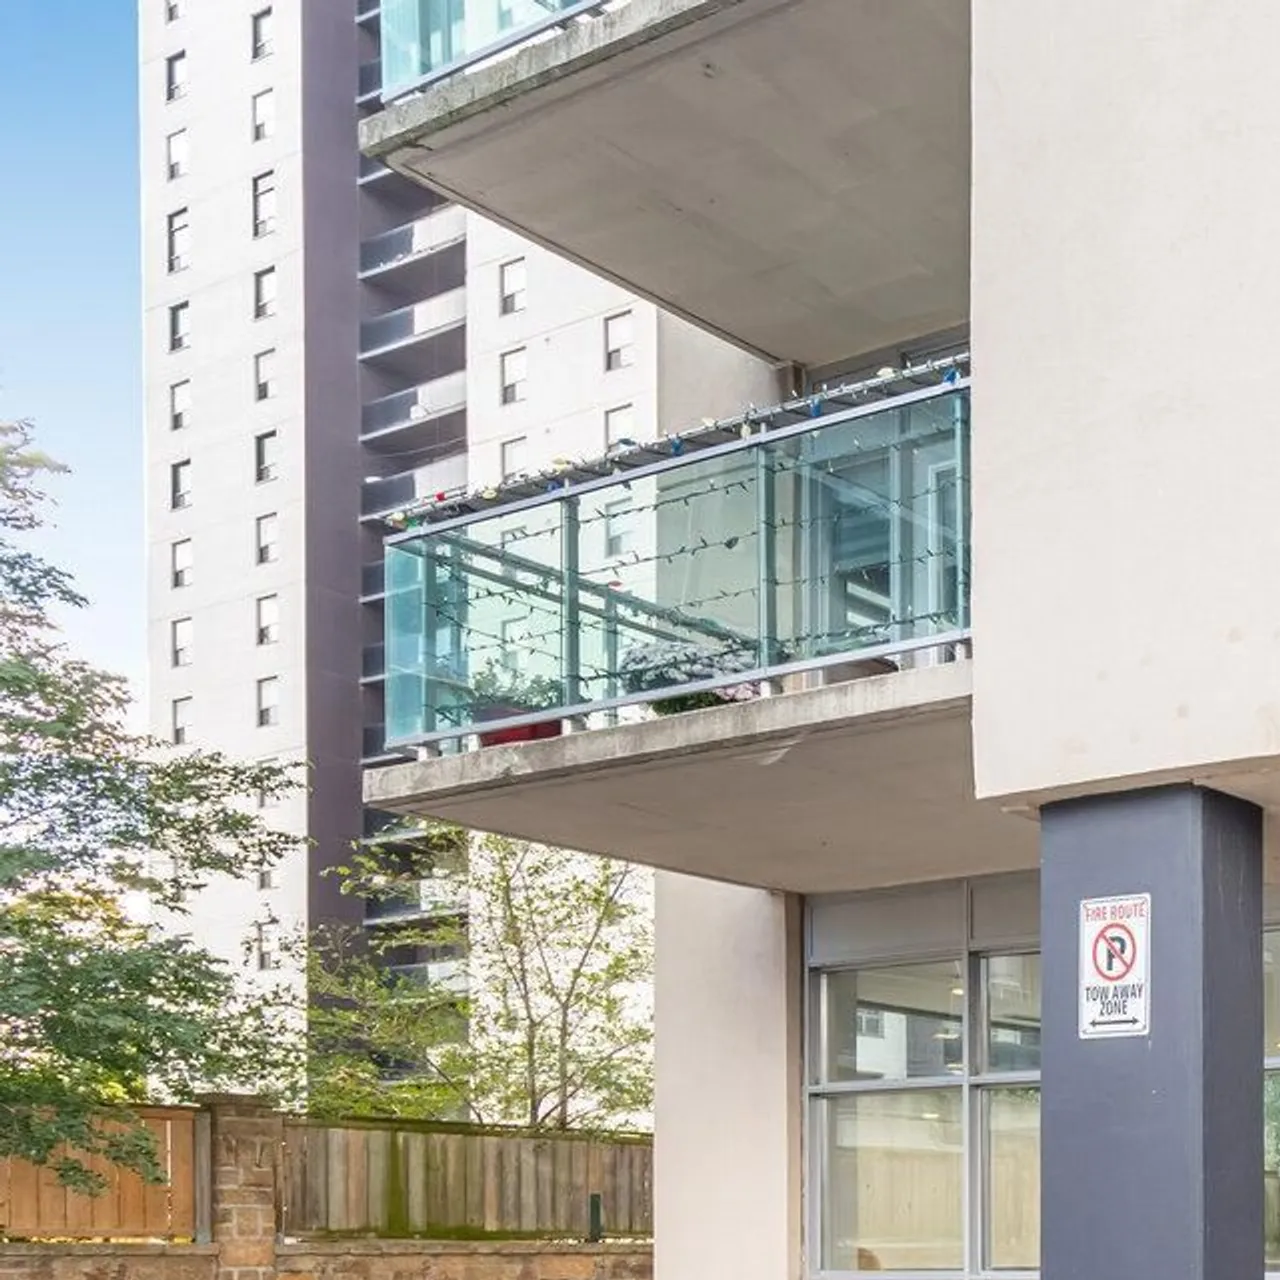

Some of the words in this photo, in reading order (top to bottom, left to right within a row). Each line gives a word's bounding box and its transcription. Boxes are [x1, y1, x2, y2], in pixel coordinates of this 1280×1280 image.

[1085, 906, 1107, 922] FIRE
[1111, 903, 1146, 920] ROUTE
[1086, 984, 1109, 1002] TOW
[1112, 983, 1144, 999] AWAY
[1100, 1000, 1128, 1016] ZONE
